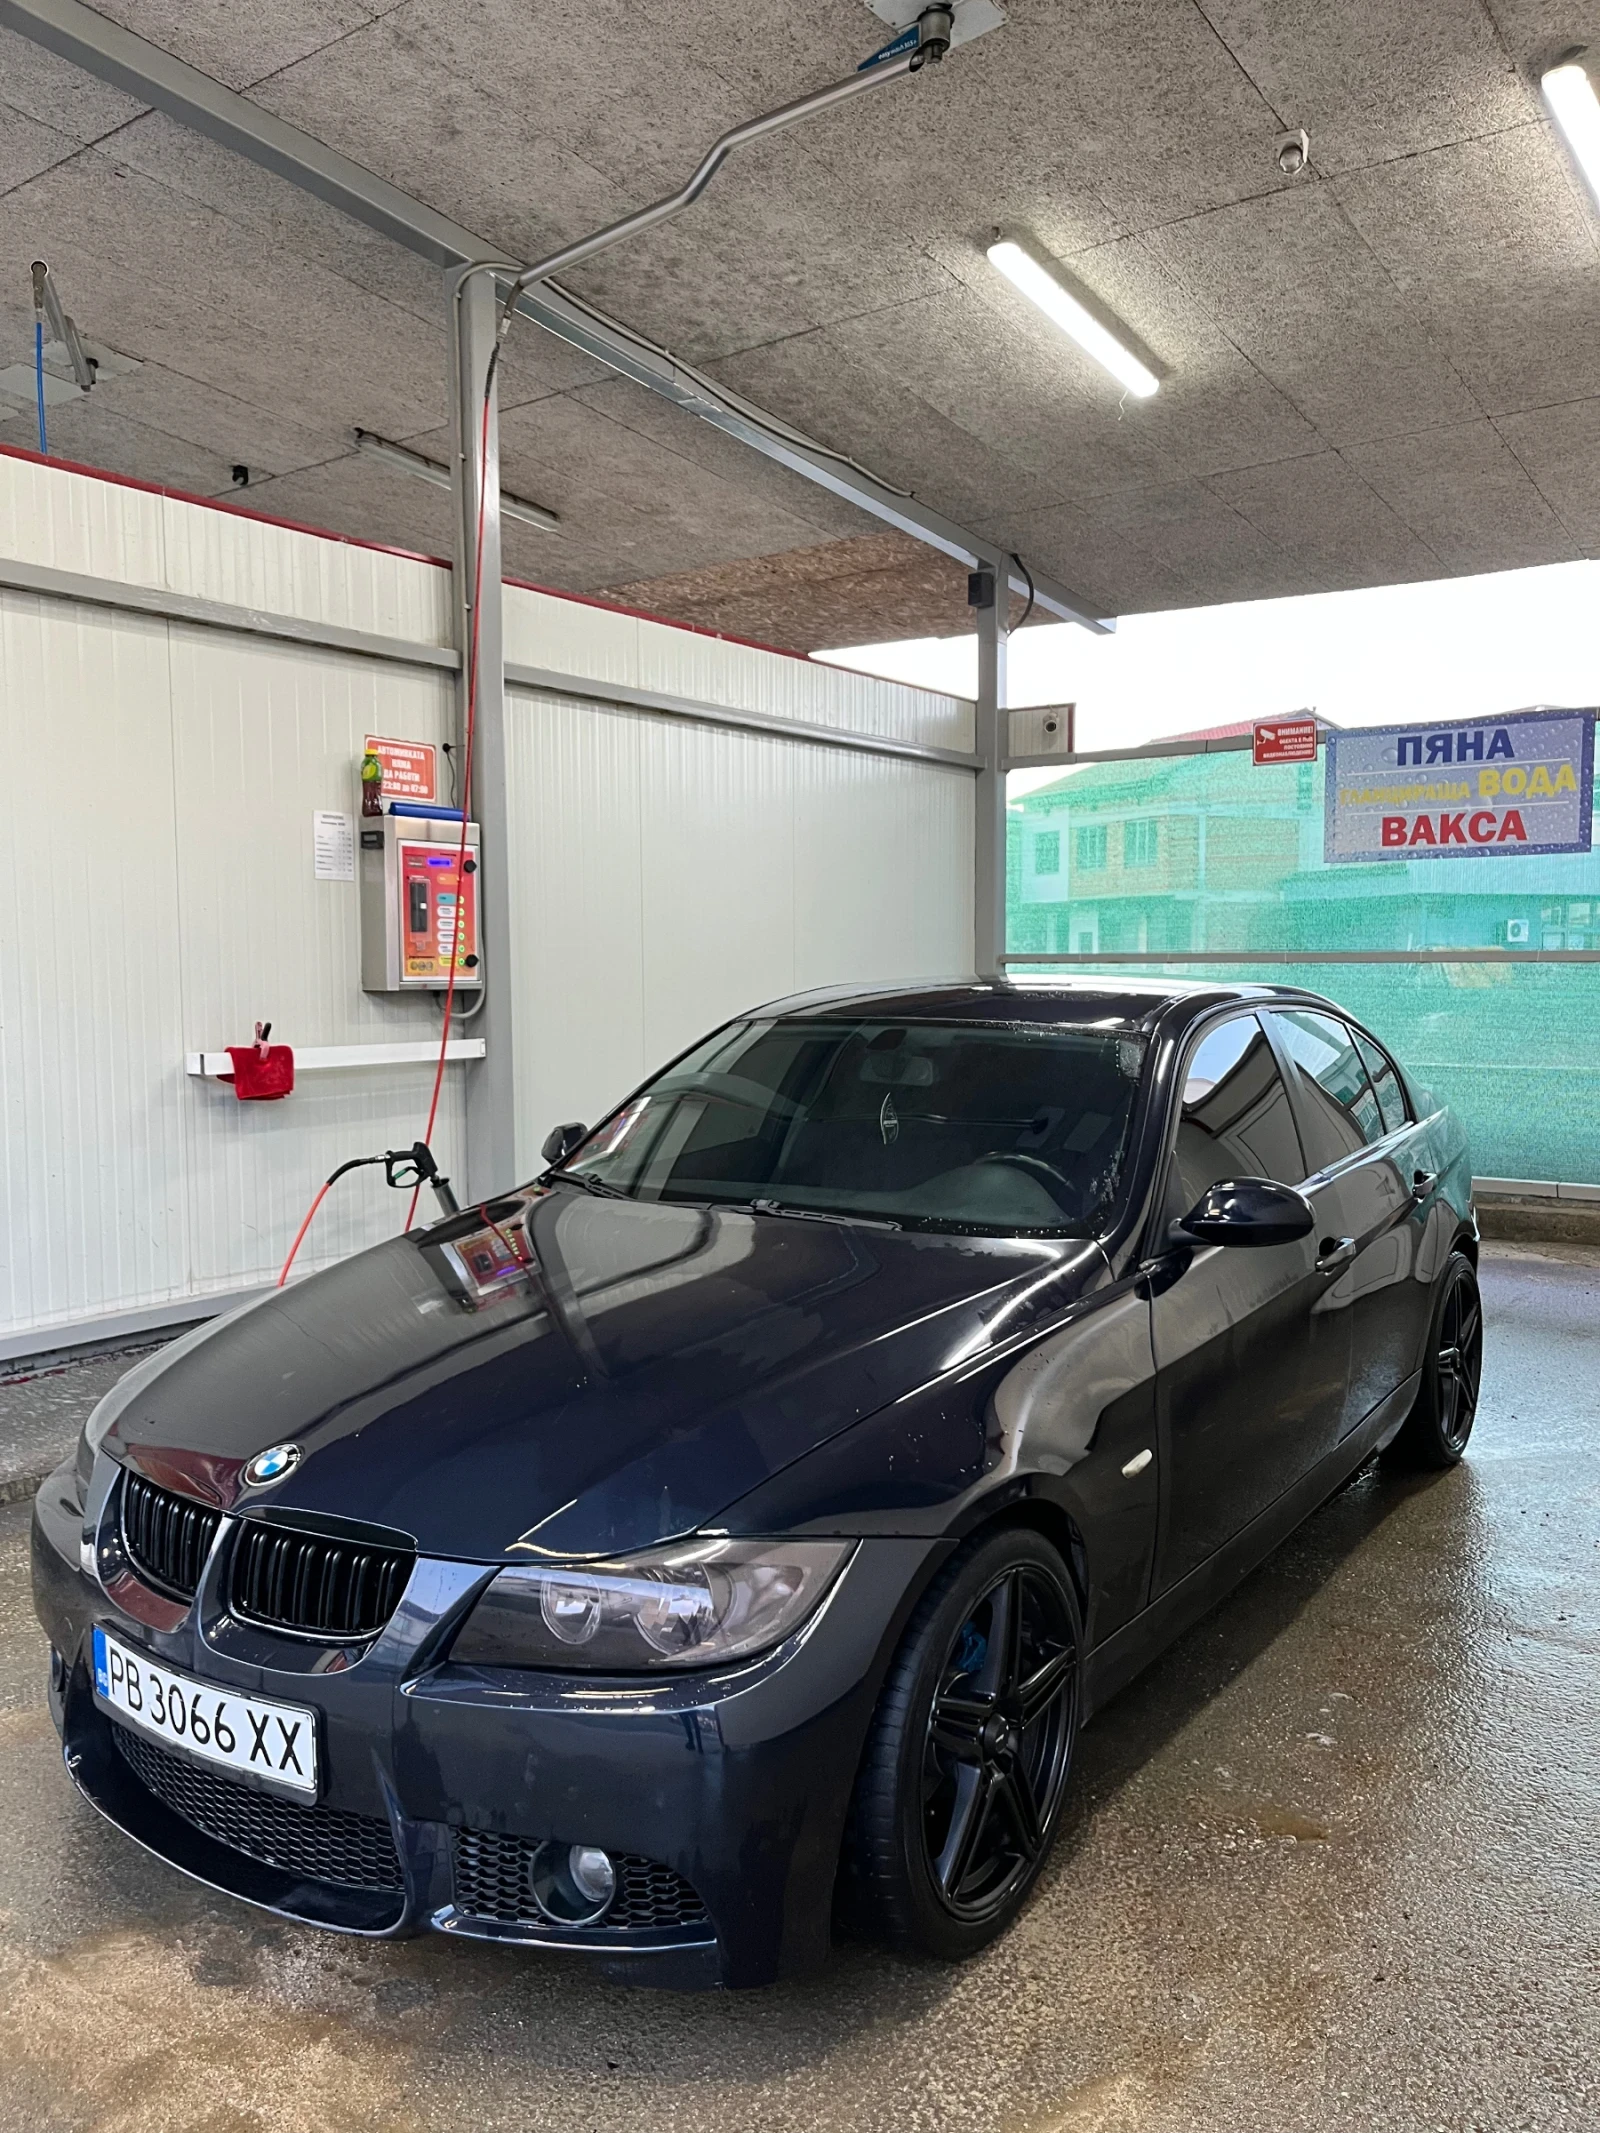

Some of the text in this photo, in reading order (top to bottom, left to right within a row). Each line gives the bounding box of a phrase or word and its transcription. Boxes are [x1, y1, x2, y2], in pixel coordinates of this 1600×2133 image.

[1277, 726, 1313, 737] ВНИМАНИЕ!
[1397, 729, 1515, 766] ПЯНА
[394, 770, 420, 782] РАБОТИ
[1340, 764, 1577, 807] ГЛАНЦИРАЩА ВОДА
[1381, 809, 1527, 847] ВАКСА
[109, 1646, 304, 1776] PB 3066 XX
